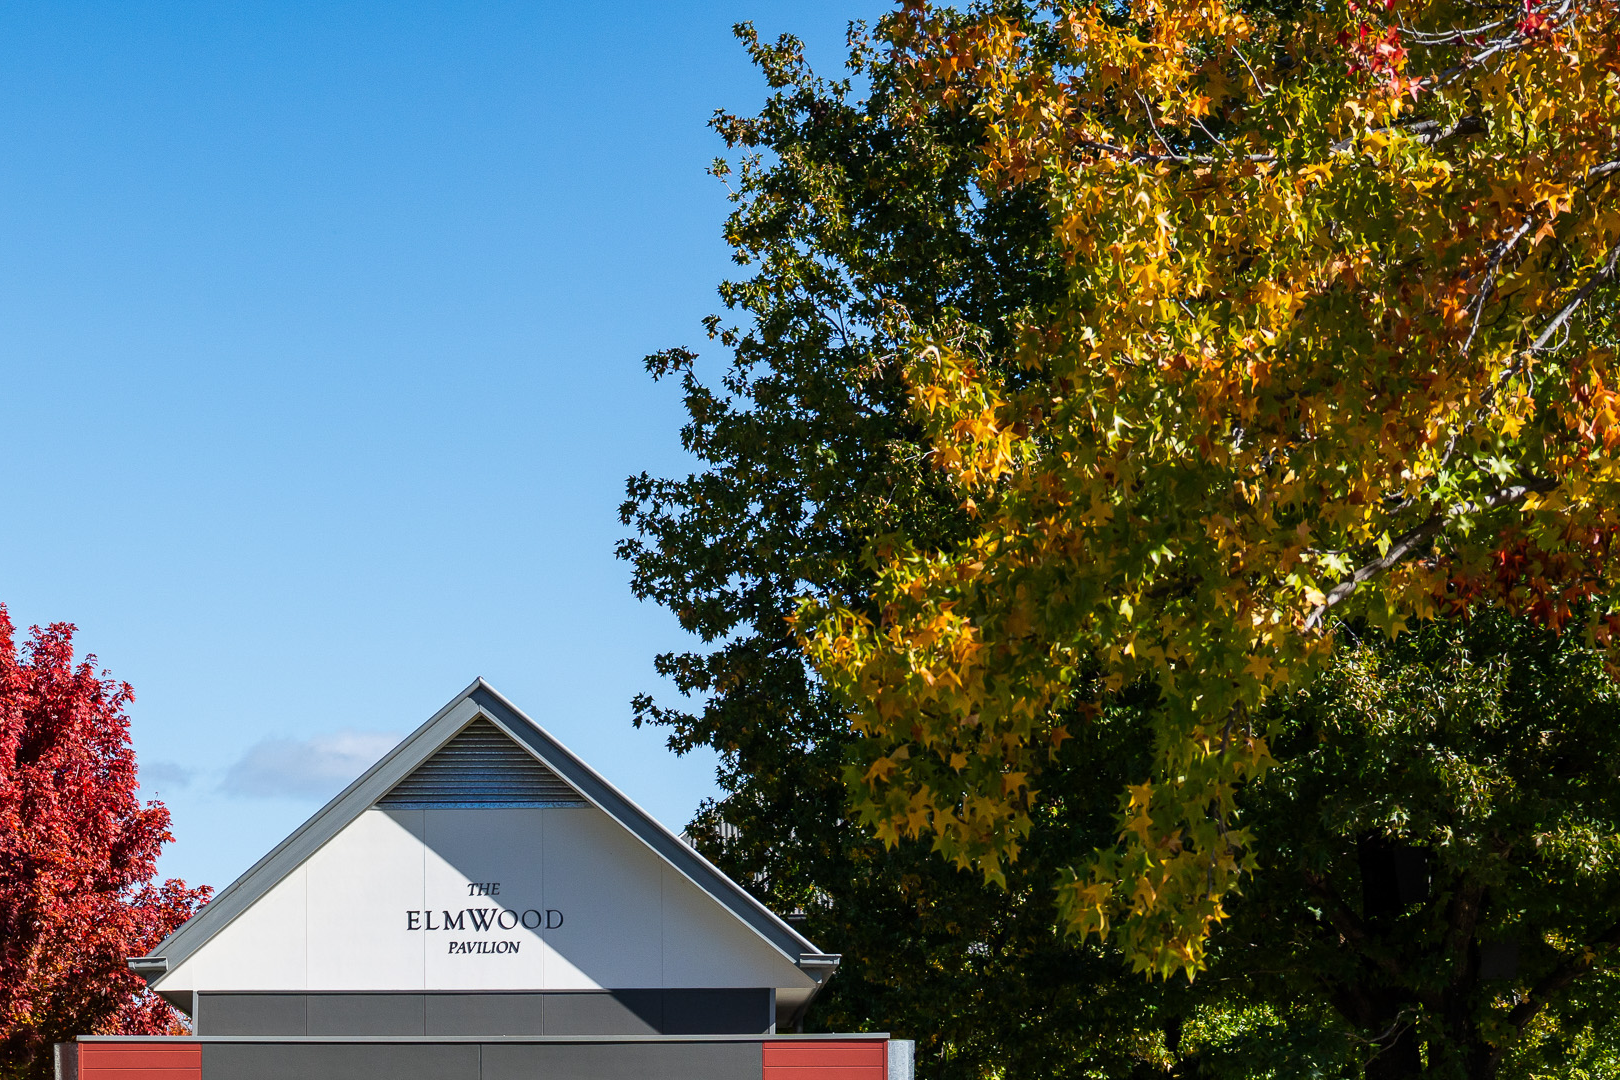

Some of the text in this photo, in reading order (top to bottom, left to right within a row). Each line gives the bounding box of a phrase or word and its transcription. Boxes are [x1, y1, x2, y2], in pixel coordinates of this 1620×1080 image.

[467, 882, 501, 897] THE
[405, 908, 564, 932] ELMWOOD
[447, 940, 521, 955] PAVILION
